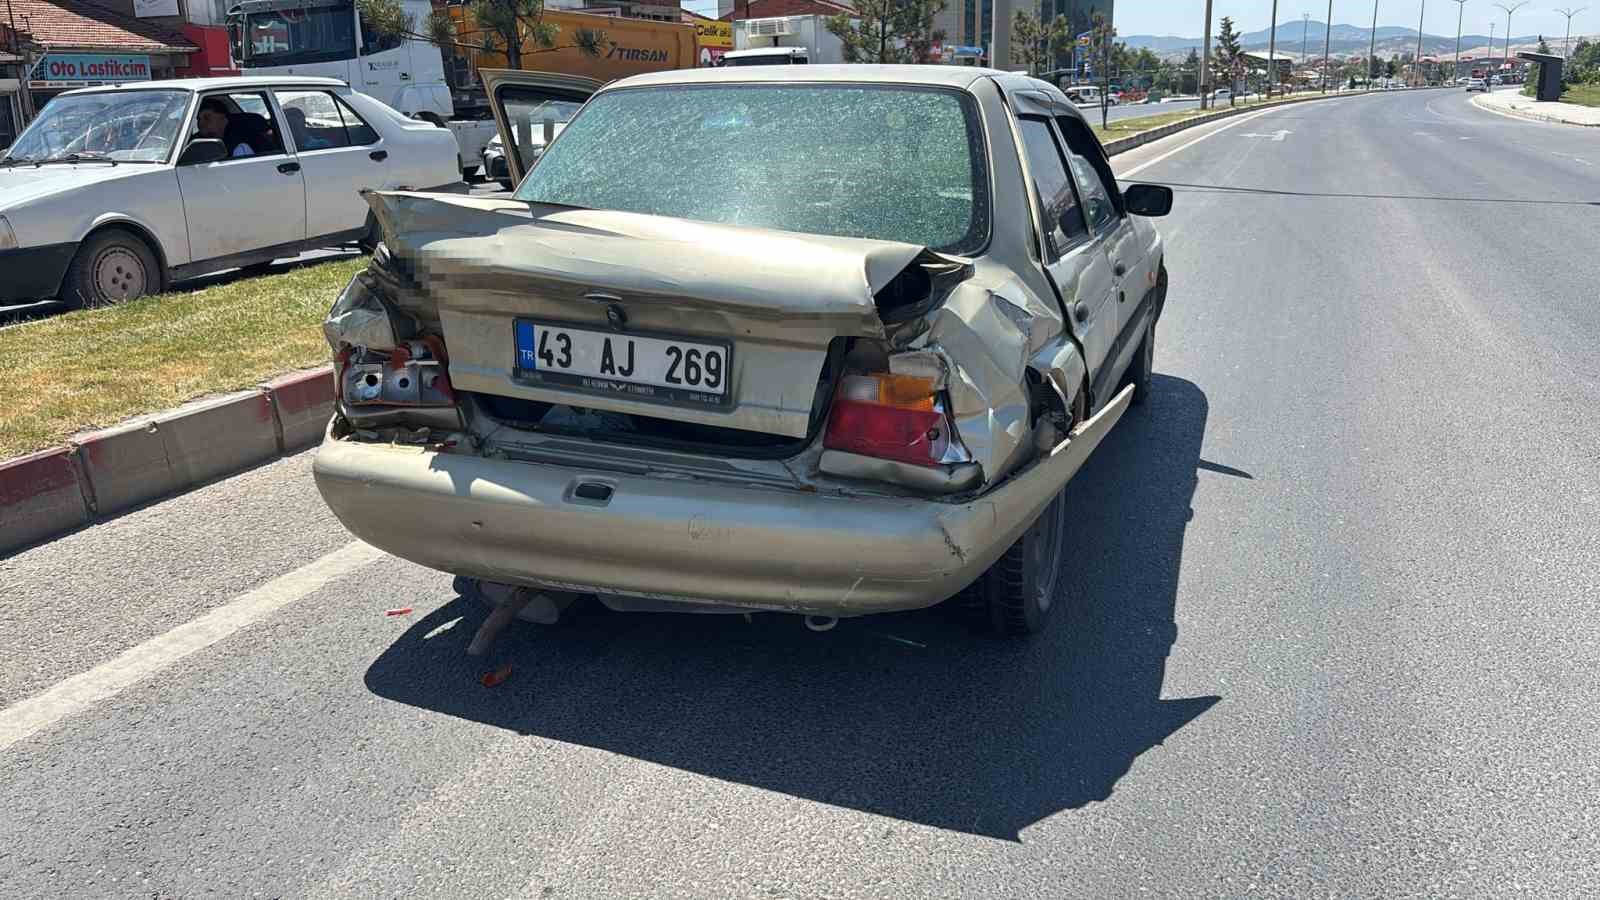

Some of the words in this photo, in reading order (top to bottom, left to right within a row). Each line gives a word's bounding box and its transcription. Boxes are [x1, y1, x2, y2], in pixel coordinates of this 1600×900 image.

[617, 47, 669, 62] TIRSAN
[51, 60, 76, 76] Oto
[521, 350, 534, 361] TR
[537, 330, 572, 368] 43
[600, 337, 635, 377] AJ
[665, 345, 722, 388] 269
